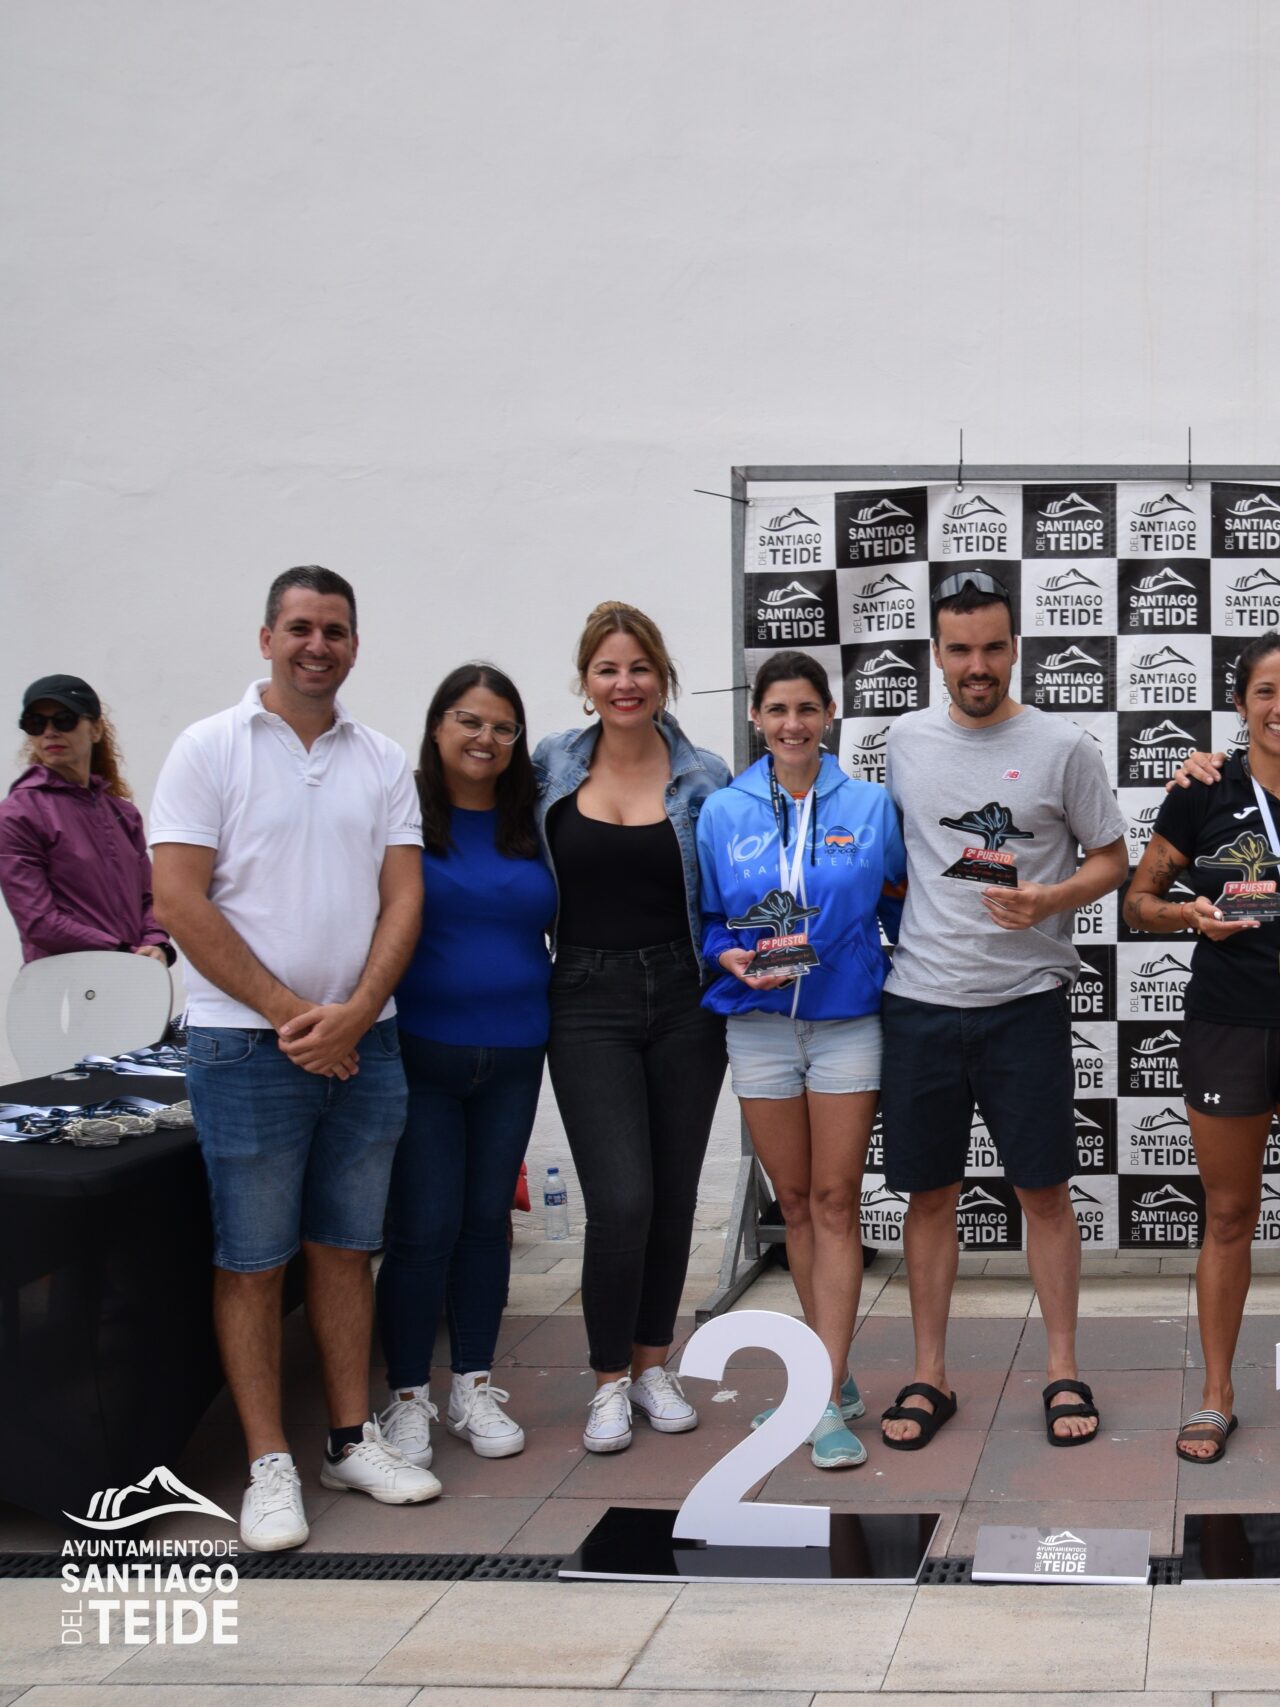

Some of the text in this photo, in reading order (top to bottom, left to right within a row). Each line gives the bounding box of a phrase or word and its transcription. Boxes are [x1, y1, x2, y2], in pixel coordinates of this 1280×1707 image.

[849, 524, 914, 539] SANTIAGO
[943, 523, 1007, 534] SANTIAGO
[1037, 519, 1103, 532] SANTIAGO
[1131, 521, 1196, 532] SANTIAGO
[759, 533, 821, 546] SANTIAGO
[953, 536, 1006, 552] TEIDE
[1047, 533, 1103, 550] TEIDE
[1141, 534, 1195, 551] TEIDE
[860, 537, 915, 558] TEIDE
[769, 547, 821, 565] TEIDE
[853, 599, 914, 614] SANTIAGO
[1037, 595, 1102, 606] SANTIAGO
[1130, 595, 1197, 607] SANTIAGO
[758, 608, 823, 620] SANTIAGO
[1047, 609, 1102, 625] TEIDE
[1140, 608, 1197, 625] TEIDE
[863, 612, 915, 632] TEIDE
[768, 621, 825, 639] TEIDE
[855, 677, 917, 690] SANTIAGO
[1036, 673, 1103, 684] SANTIAGO
[1130, 673, 1196, 685] SANTIAGO
[862, 690, 917, 708] TEIDE
[1046, 686, 1103, 703] TEIDE
[1141, 687, 1196, 703] TEIDE
[1130, 747, 1197, 759] SANTIAGO
[978, 850, 1011, 863] PUESTO
[1240, 883, 1274, 893] PUESTO
[772, 935, 804, 947] PUESTO
[1130, 982, 1187, 993] SANTIAG
[1141, 995, 1185, 1012] TEID
[1132, 1211, 1198, 1222] SANTIAGO
[1142, 1224, 1198, 1241] TEIDE
[672, 1310, 833, 1547] 2
[1036, 1552, 1086, 1560] SANTIAGO
[1043, 1560, 1085, 1572] TEIDE
